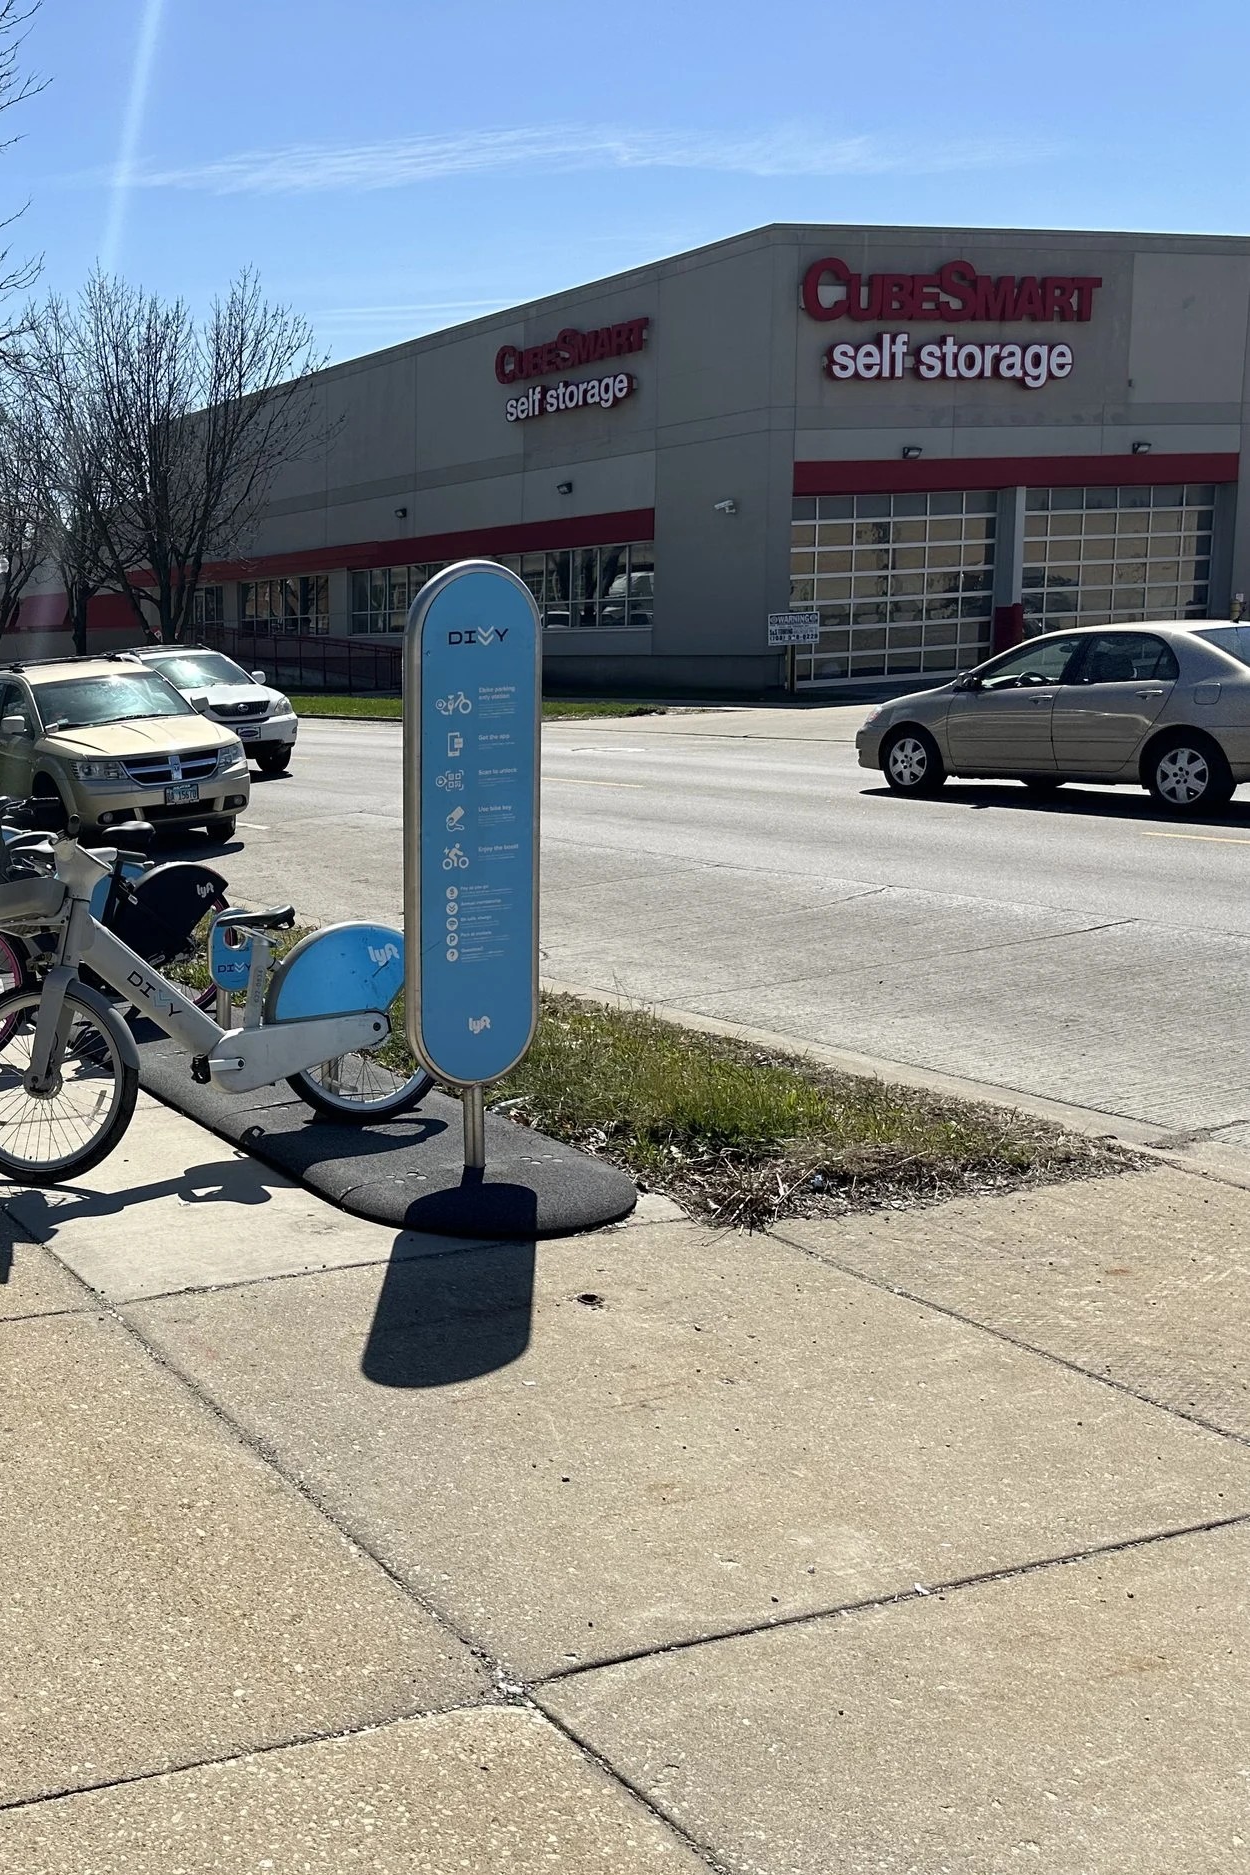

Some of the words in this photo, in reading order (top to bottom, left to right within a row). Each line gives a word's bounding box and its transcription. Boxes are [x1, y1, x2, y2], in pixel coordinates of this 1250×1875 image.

[831, 333, 909, 379] self
[918, 336, 1074, 388] storage
[506, 386, 542, 422] self
[546, 373, 628, 409] storage
[778, 614, 809, 623] WARNING
[196, 882, 215, 899] lyft
[367, 943, 400, 967] lyft
[468, 1015, 491, 1034] lyft
